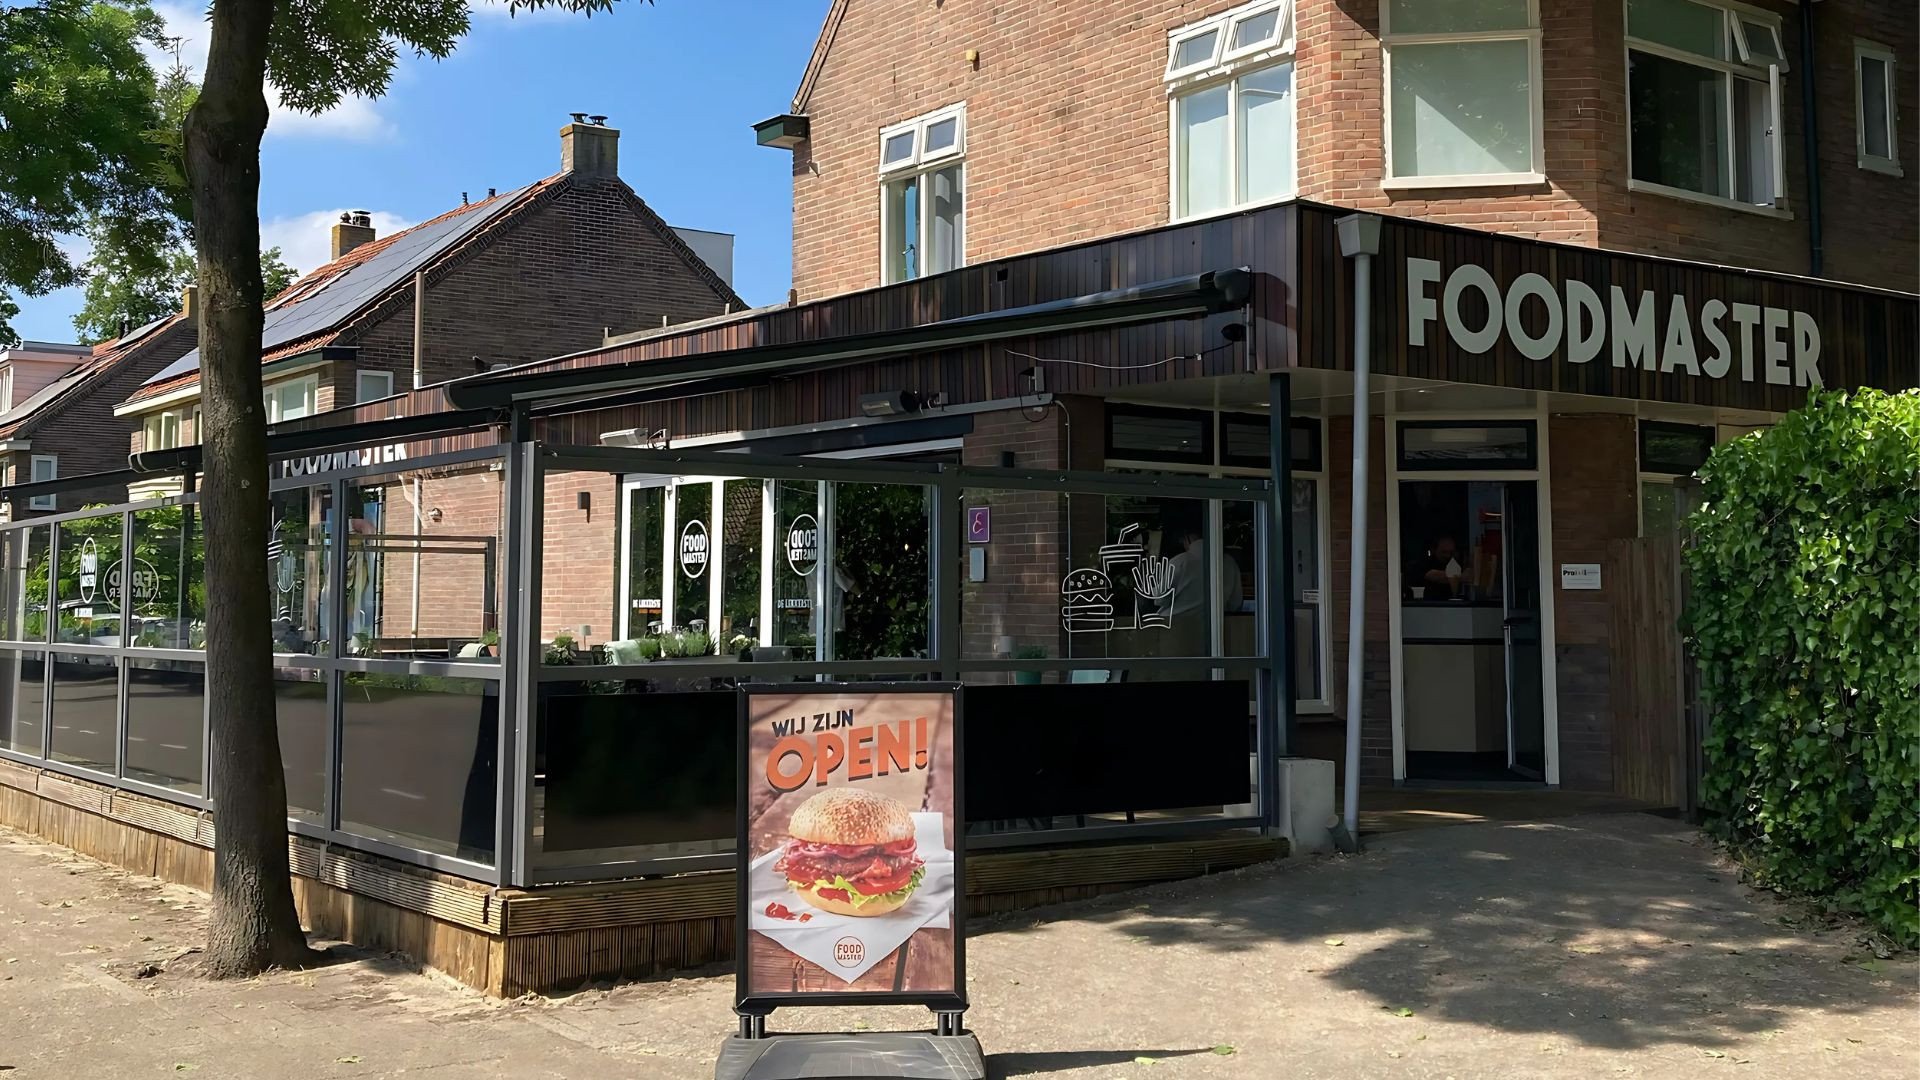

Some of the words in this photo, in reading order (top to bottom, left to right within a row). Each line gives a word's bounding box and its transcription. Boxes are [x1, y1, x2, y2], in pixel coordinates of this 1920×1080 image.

[1407, 257, 1823, 388] FOODMASTER
[683, 534, 706, 552] FOOD
[772, 716, 806, 737] WIJ
[812, 709, 854, 732] ZIJN
[766, 717, 928, 793] OPEN!
[837, 944, 862, 954] FOOD
